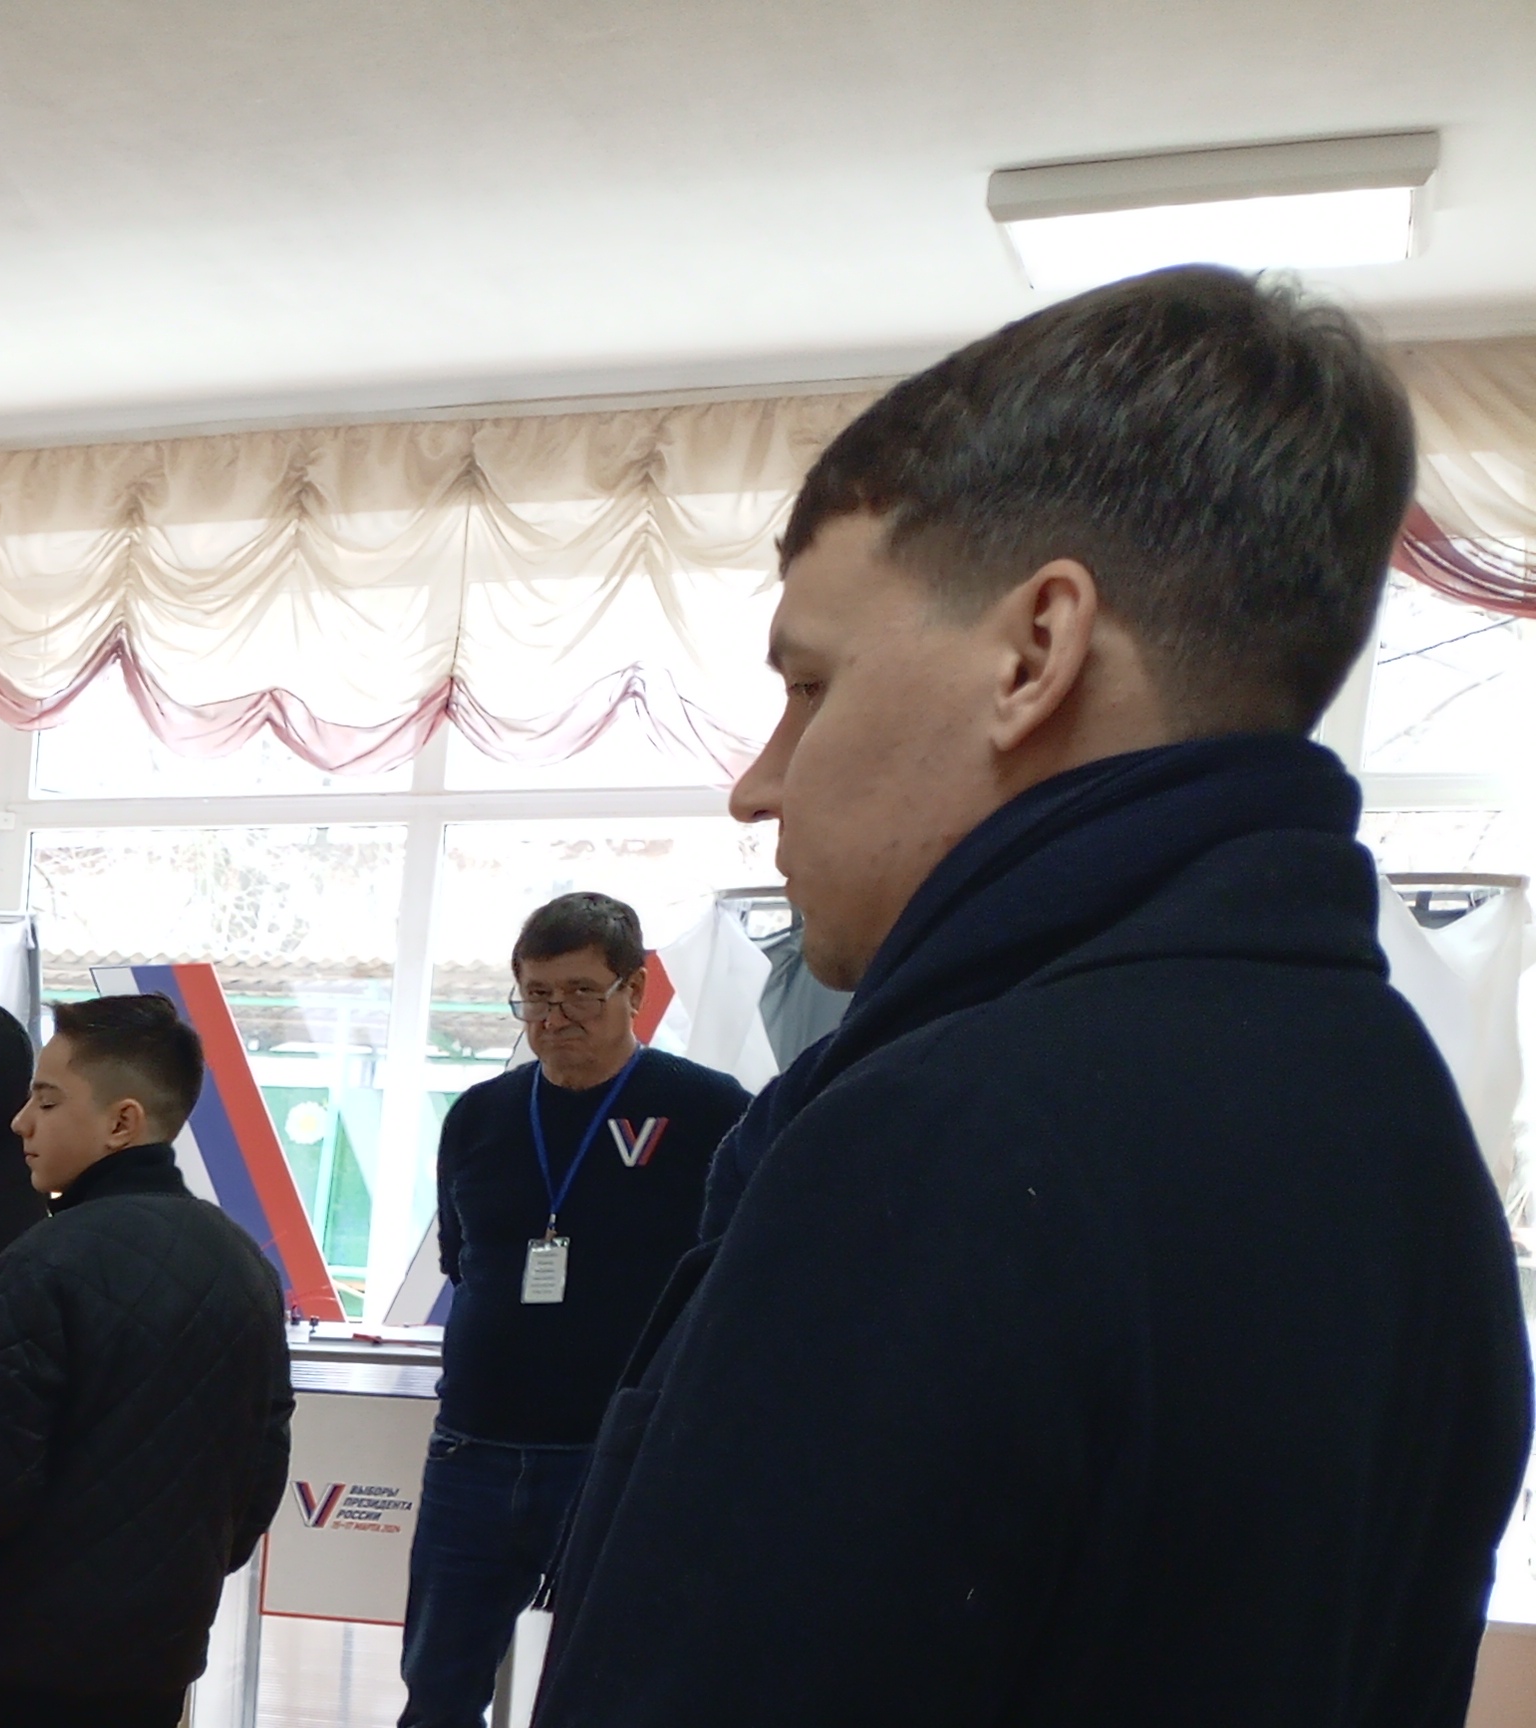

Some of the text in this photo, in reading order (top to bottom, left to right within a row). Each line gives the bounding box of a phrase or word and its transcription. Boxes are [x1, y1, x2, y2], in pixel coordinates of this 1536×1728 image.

[350, 1485, 400, 1498] ВЫБОРЫ
[343, 1497, 413, 1511] ПРЕЗИДЕНТА
[336, 1509, 383, 1521] РОССИИ
